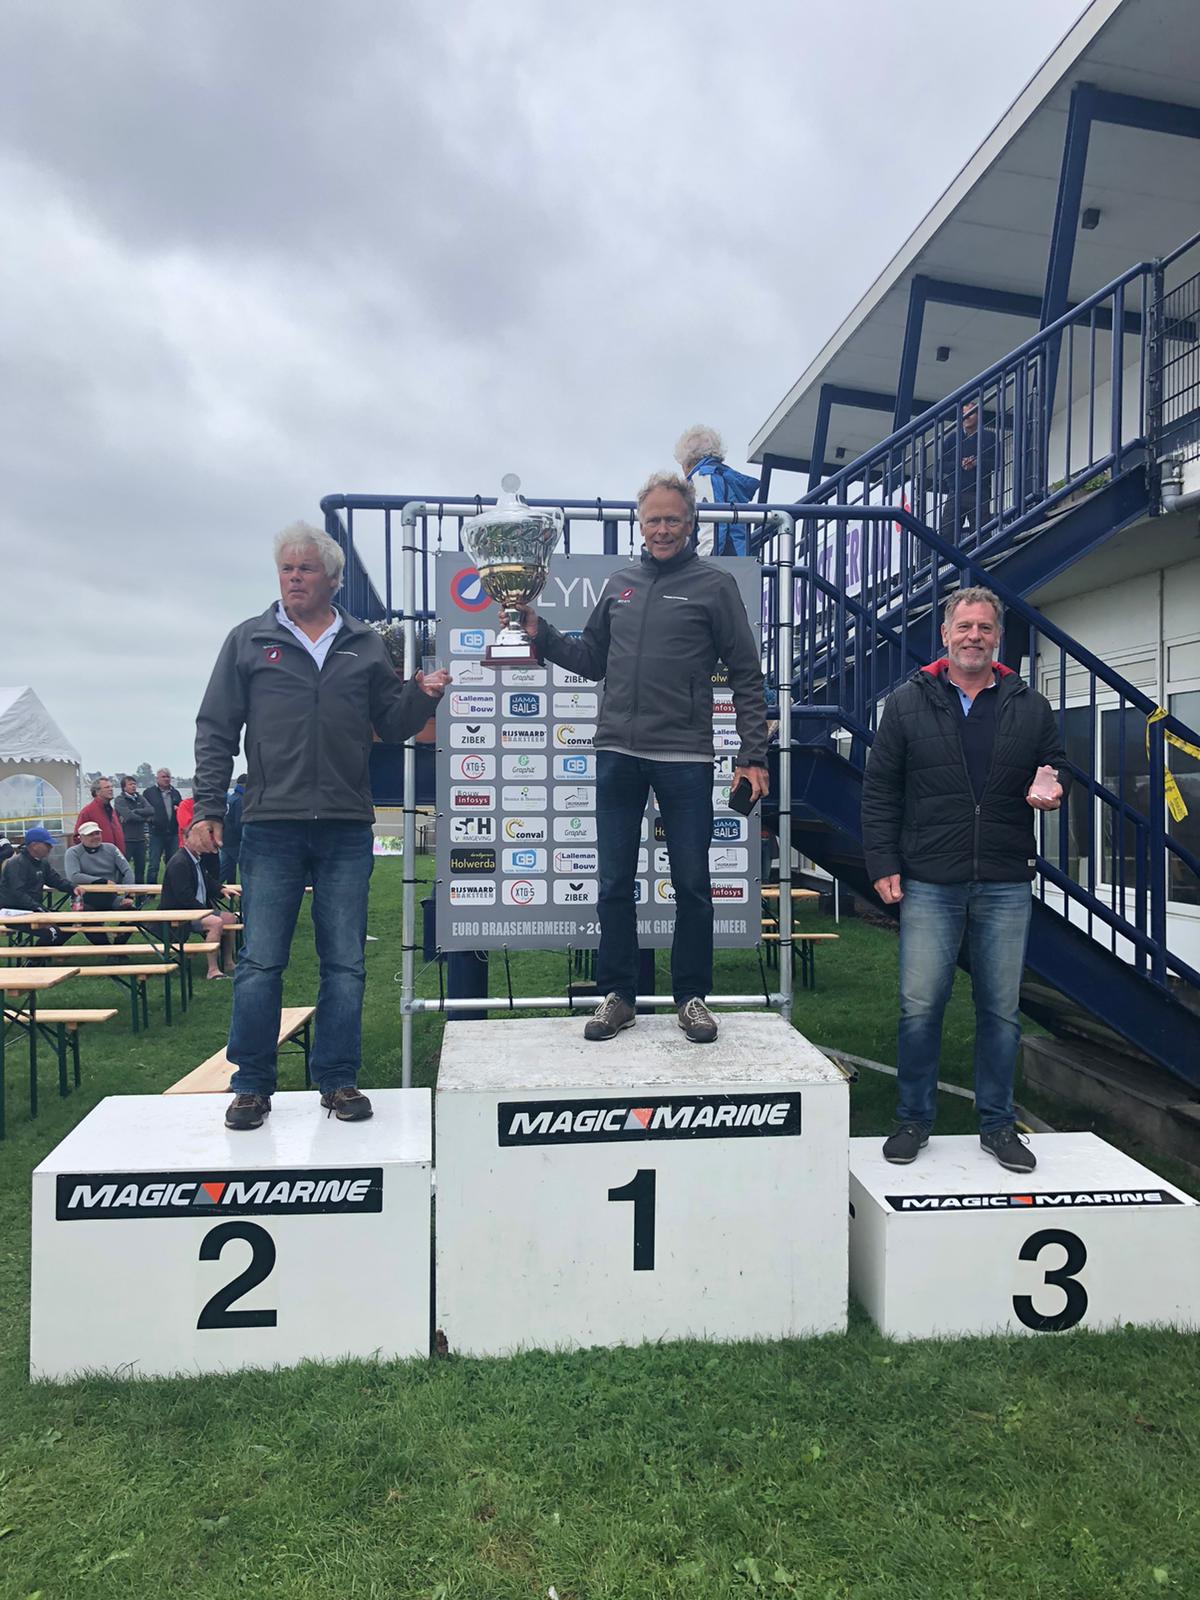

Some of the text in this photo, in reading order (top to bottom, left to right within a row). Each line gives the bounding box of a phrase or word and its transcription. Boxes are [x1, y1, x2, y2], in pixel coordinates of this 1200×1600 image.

[564, 675, 588, 683] ZIBER
[512, 703, 537, 713] SAILS
[461, 736, 486, 744] ZIBER
[458, 796, 488, 804] infosys
[516, 831, 544, 839] conval
[714, 829, 738, 838] SAILS
[451, 859, 495, 868] Holwerda
[712, 889, 742, 897] infosys
[565, 894, 589, 902] ZIBER
[452, 922, 480, 937] EURO
[508, 1103, 791, 1136] MAGIC MARINE
[67, 1179, 373, 1209] MAGIC MARINE
[901, 1192, 1163, 1209] MAGIC MARINE
[607, 1168, 657, 1271] 1
[196, 1220, 278, 1331] 2
[1011, 1228, 1089, 1333] 3
